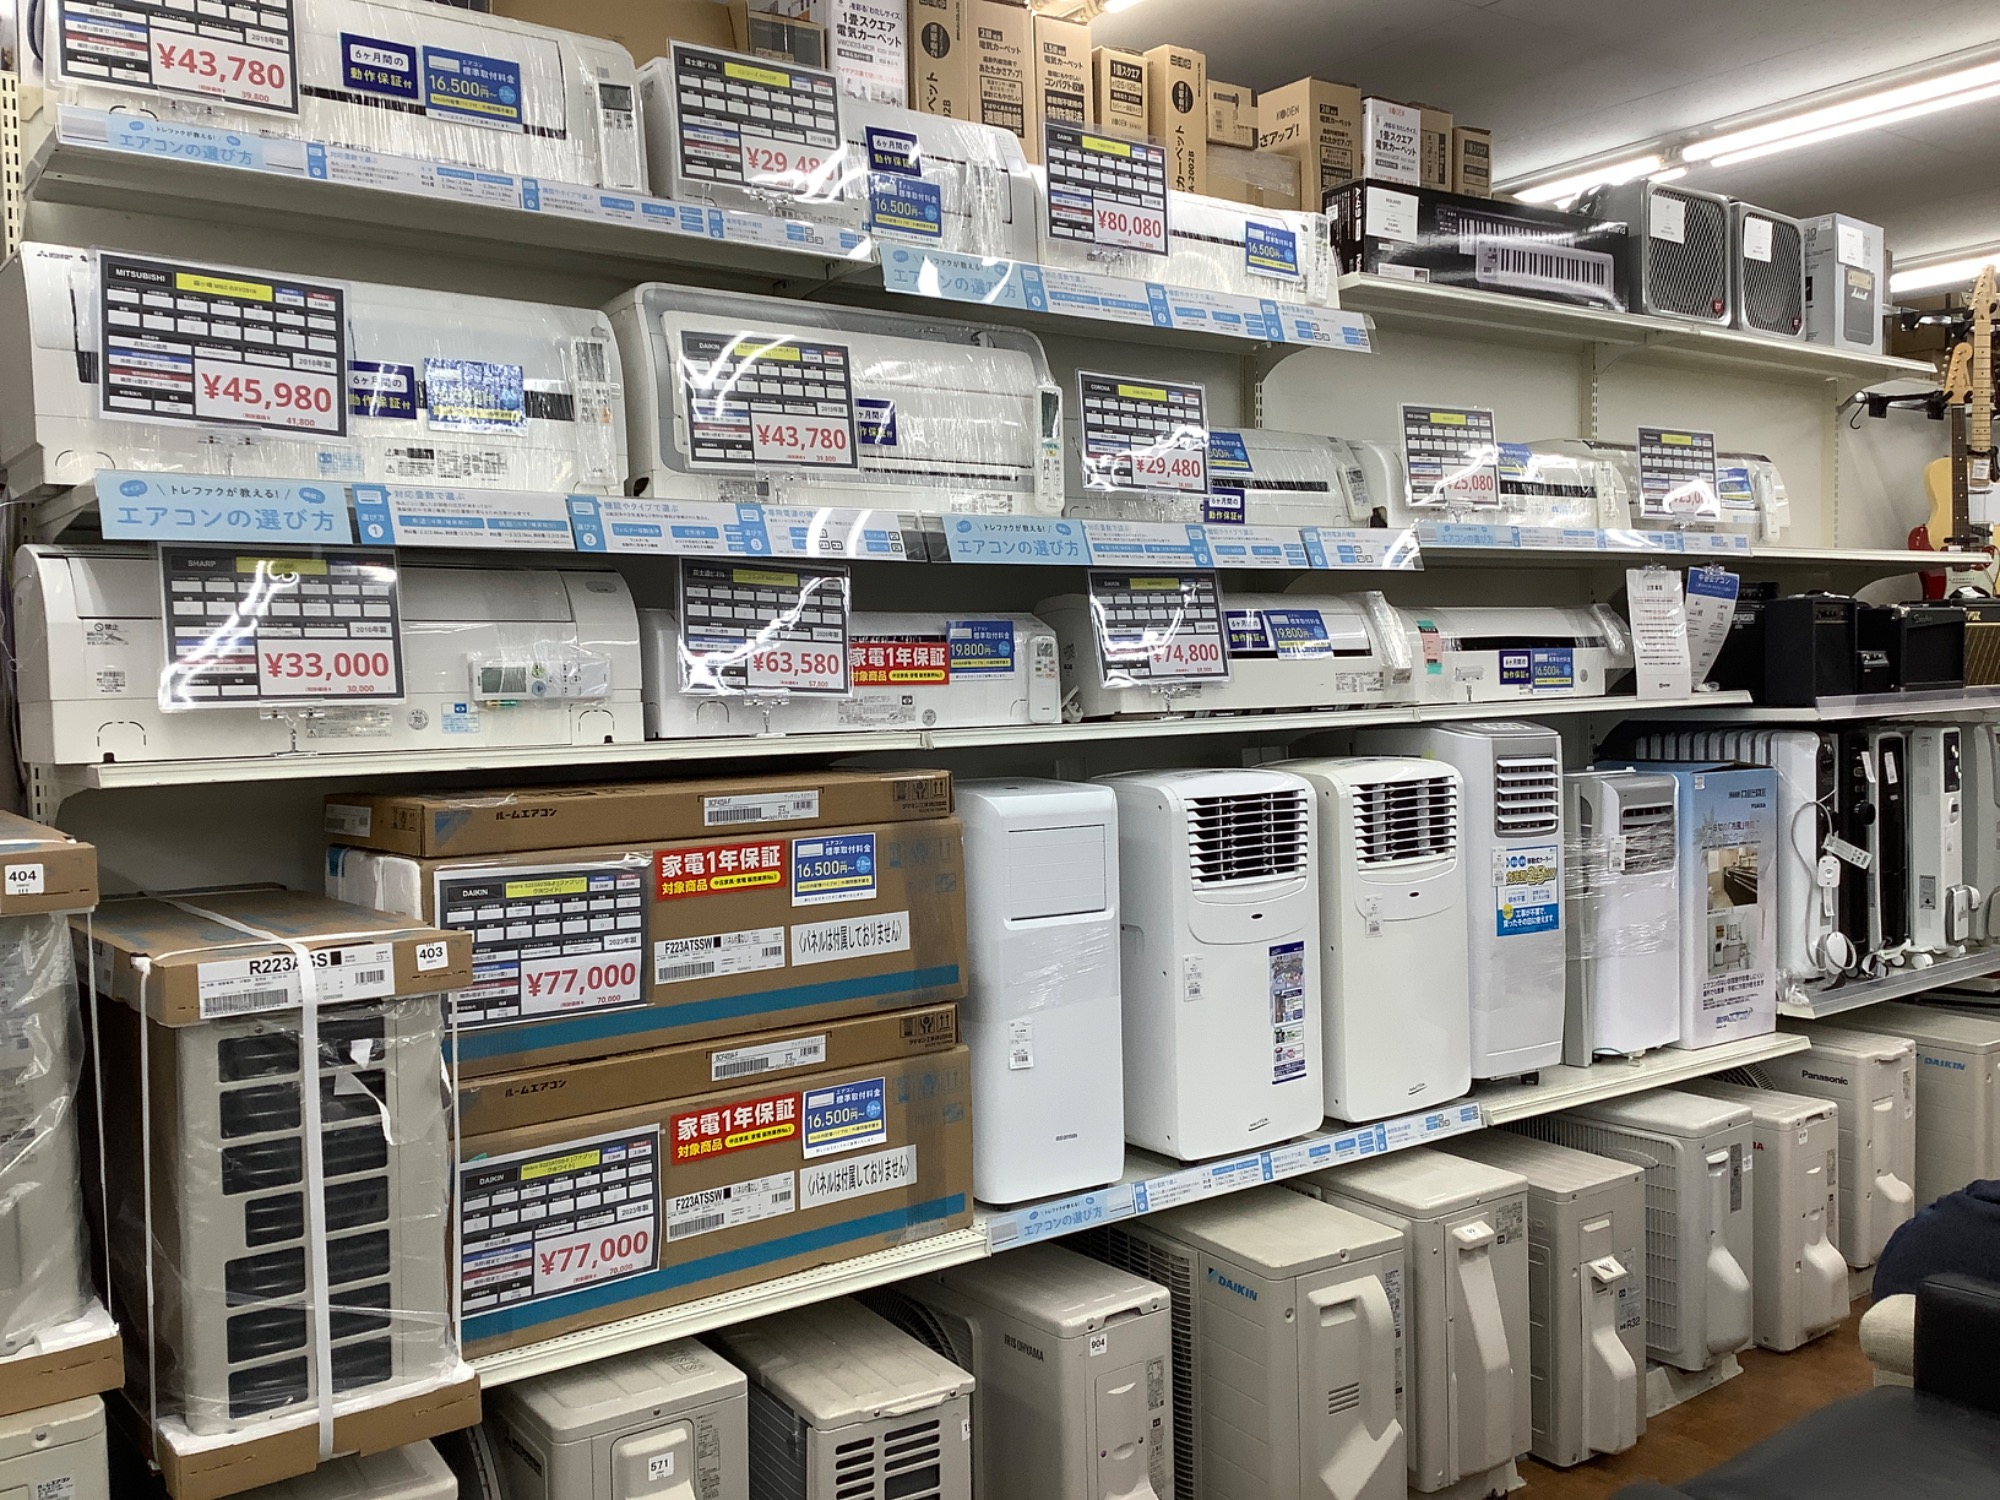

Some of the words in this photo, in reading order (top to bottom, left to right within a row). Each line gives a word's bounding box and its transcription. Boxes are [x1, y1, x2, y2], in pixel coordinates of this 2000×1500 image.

[843, 12, 896, 32] 1畳スクエア
[836, 23, 902, 48] 電気カーペット
[979, 40, 1021, 55] 電気カーペット
[157, 43, 285, 89] ¥43,780
[1044, 55, 1083, 69] 電気カーペット
[350, 67, 412, 89] 動作保証付
[462, 66, 515, 84] 標準取付料金
[1113, 63, 1140, 80] 1畳スクエア
[241, 90, 269, 102] 39,800
[1380, 130, 1413, 145] 1畳スクエア
[119, 133, 254, 166] エアコンの選び方
[1375, 139, 1417, 156] 電気カーペット
[1098, 209, 1162, 239] ¥80,080
[115, 268, 166, 283] MITSUBISHI
[699, 341, 721, 350] DAIKIN
[201, 372, 332, 414] ¥45,980
[286, 416, 315, 427] 41,800
[756, 423, 847, 451] ¥43,780
[1136, 457, 1201, 479] ¥29,480
[394, 490, 465, 501] 対応畳数で選ぶ
[604, 501, 679, 513] 機能やタイプで選ぶ
[1208, 511, 1242, 520] 動作保証付
[117, 507, 334, 533] エアコンの選び方
[361, 513, 386, 522] 選び方
[576, 523, 597, 532] 選び方
[957, 539, 1080, 557] エアコンの選び方
[187, 559, 217, 568] SHARP
[973, 631, 1010, 640] 標準取付料金
[753, 651, 840, 677] ¥63,580
[849, 646, 945, 668] 家電1年保証
[264, 652, 389, 681] ¥33,000
[1503, 670, 1529, 679] 動作保証付
[850, 669, 887, 682] 対象商品
[346, 685, 374, 693] 30,000
[495, 807, 558, 821] ルームエアコン
[825, 843, 871, 856] 標準取付料金
[662, 845, 781, 878] 家電1年保証
[8, 868, 37, 883] 404
[462, 888, 489, 898] DAIKIN
[662, 879, 708, 896] 対象商品
[419, 946, 444, 959] 403
[665, 938, 713, 954] F223ATSSW
[249, 951, 328, 975] R223ASS
[526, 962, 636, 997] ¥77,000
[597, 994, 621, 1004] 70,000
[1924, 1056, 1966, 1072] DAIKIN
[1801, 1069, 1848, 1086] Panasonic
[505, 1079, 568, 1098] ルームエアコン
[836, 1088, 881, 1105] 標準取付料金
[677, 1097, 795, 1141] 家電1年保証
[677, 1138, 723, 1159] 対象商品
[479, 1173, 505, 1186] DAIKIN
[675, 1189, 723, 1211] F223ATSSW
[1024, 1208, 1103, 1236] エアコンの選び方
[540, 1230, 649, 1276] ¥77,000
[609, 1263, 633, 1275] 70,000
[1218, 1274, 1259, 1301] DAIKIN
[1004, 1333, 1017, 1350] IRIS
[1017, 1340, 1045, 1363] OHYAMA
[1091, 1338, 1106, 1350] 904
[650, 1459, 669, 1473] 571
